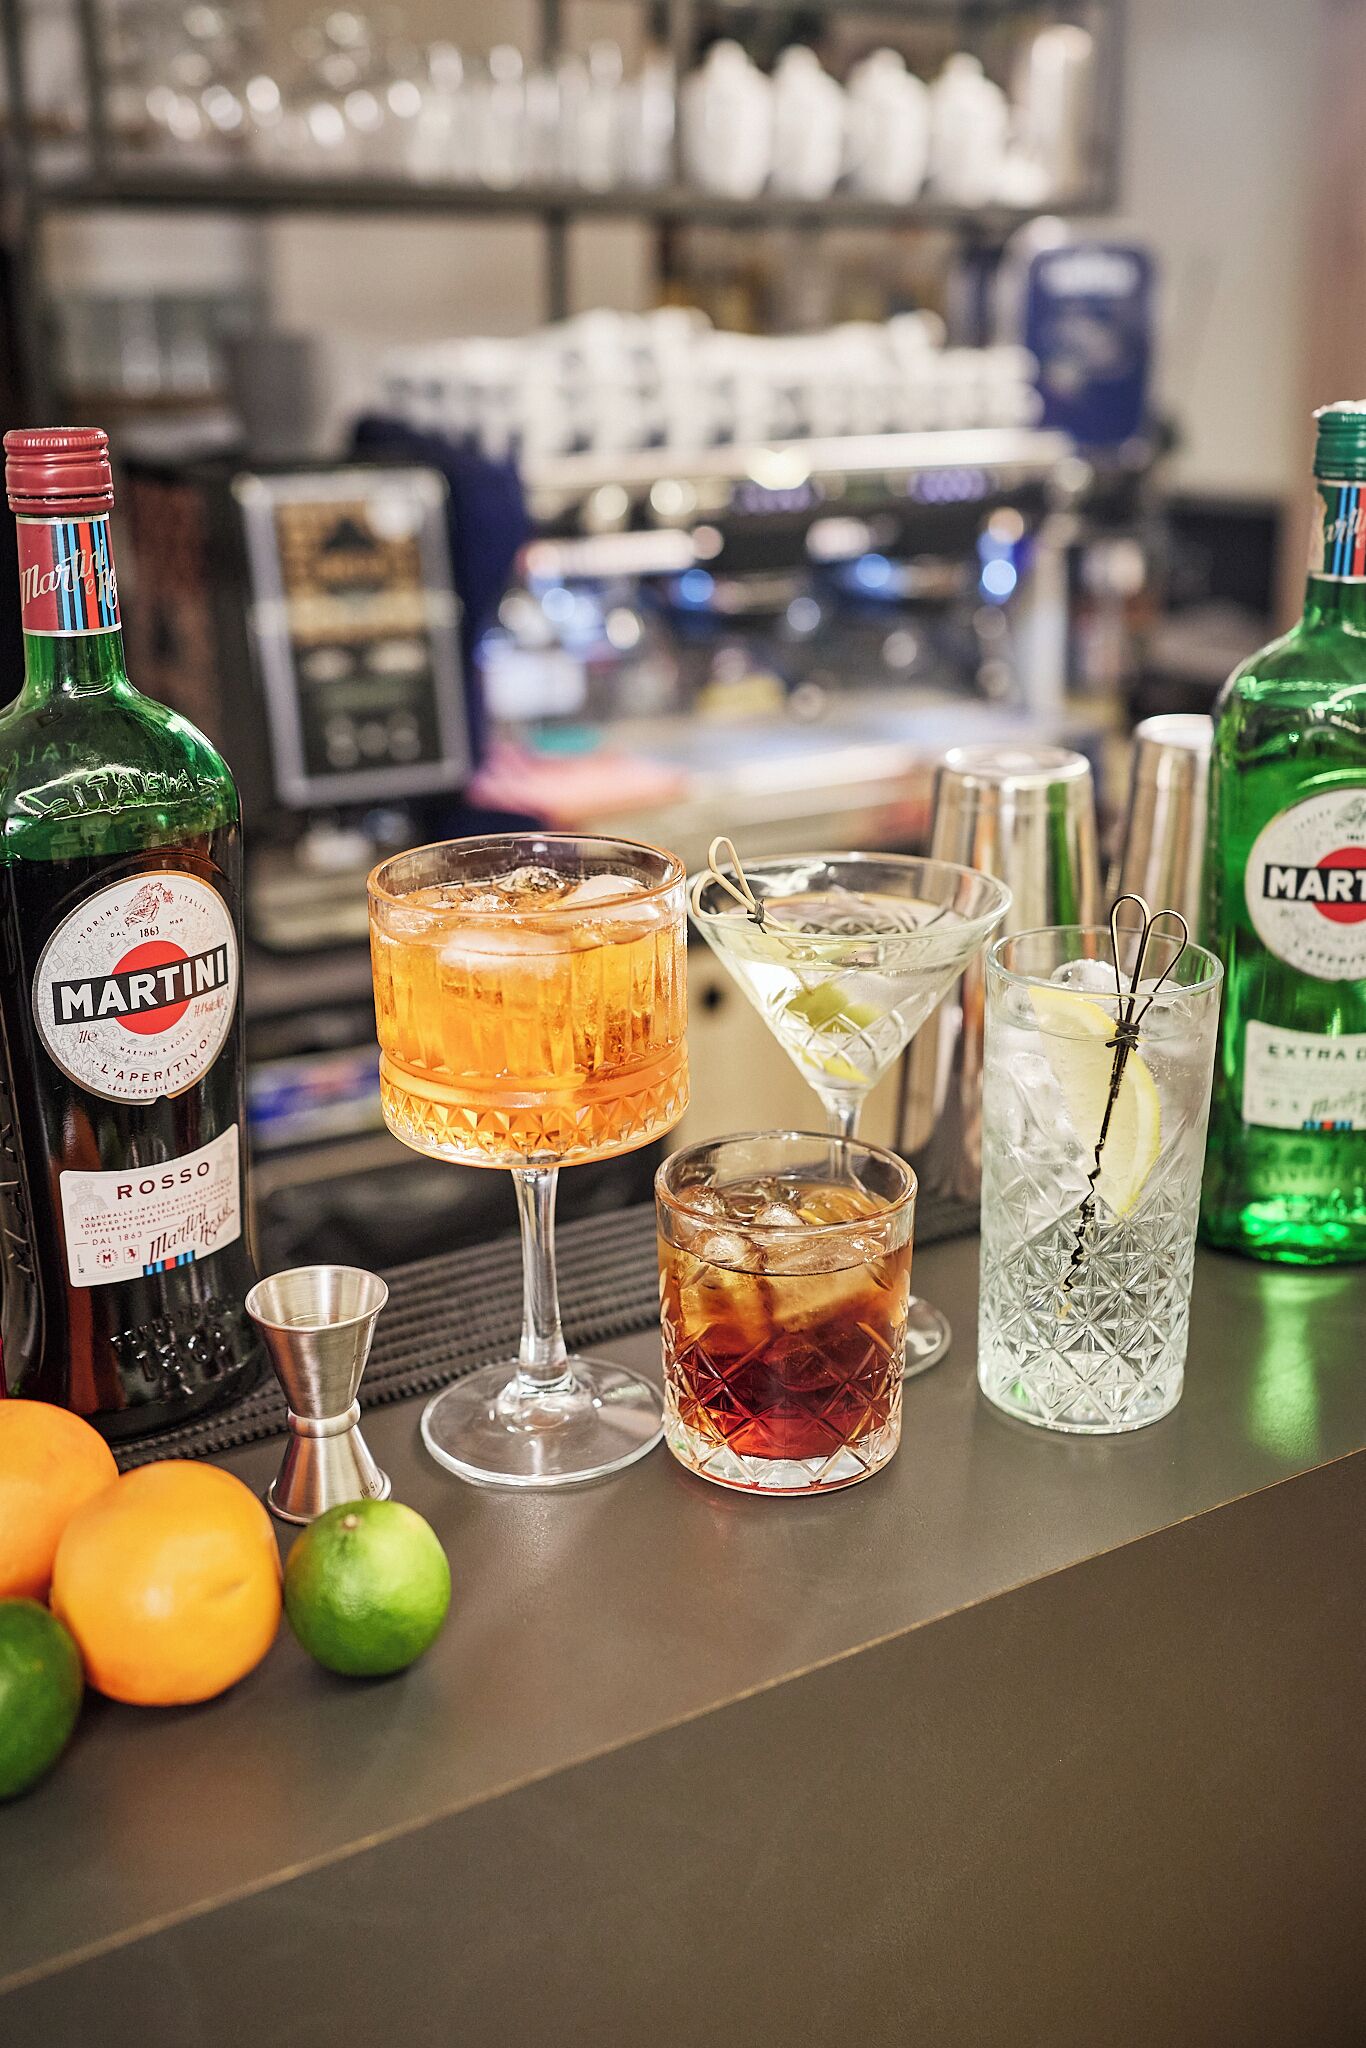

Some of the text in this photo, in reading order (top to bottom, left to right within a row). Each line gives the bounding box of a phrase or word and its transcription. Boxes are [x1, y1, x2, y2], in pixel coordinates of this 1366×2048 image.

[21, 539, 106, 612] Martini
[179, 894, 207, 914] ITALIA
[80, 905, 120, 940] TORINO
[139, 925, 160, 938] 1863
[60, 949, 226, 1020] MARTINI
[101, 1039, 207, 1082] L'APERITIVO
[120, 1046, 158, 1057] MARTINI
[116, 1161, 210, 1200] ROSSO
[80, 1219, 119, 1230] SOURCED
[123, 1214, 145, 1222] FROM
[84, 1210, 133, 1222] NATURALLY
[84, 1223, 132, 1236] DIFFERENT
[92, 1230, 142, 1246] DAL 1863
